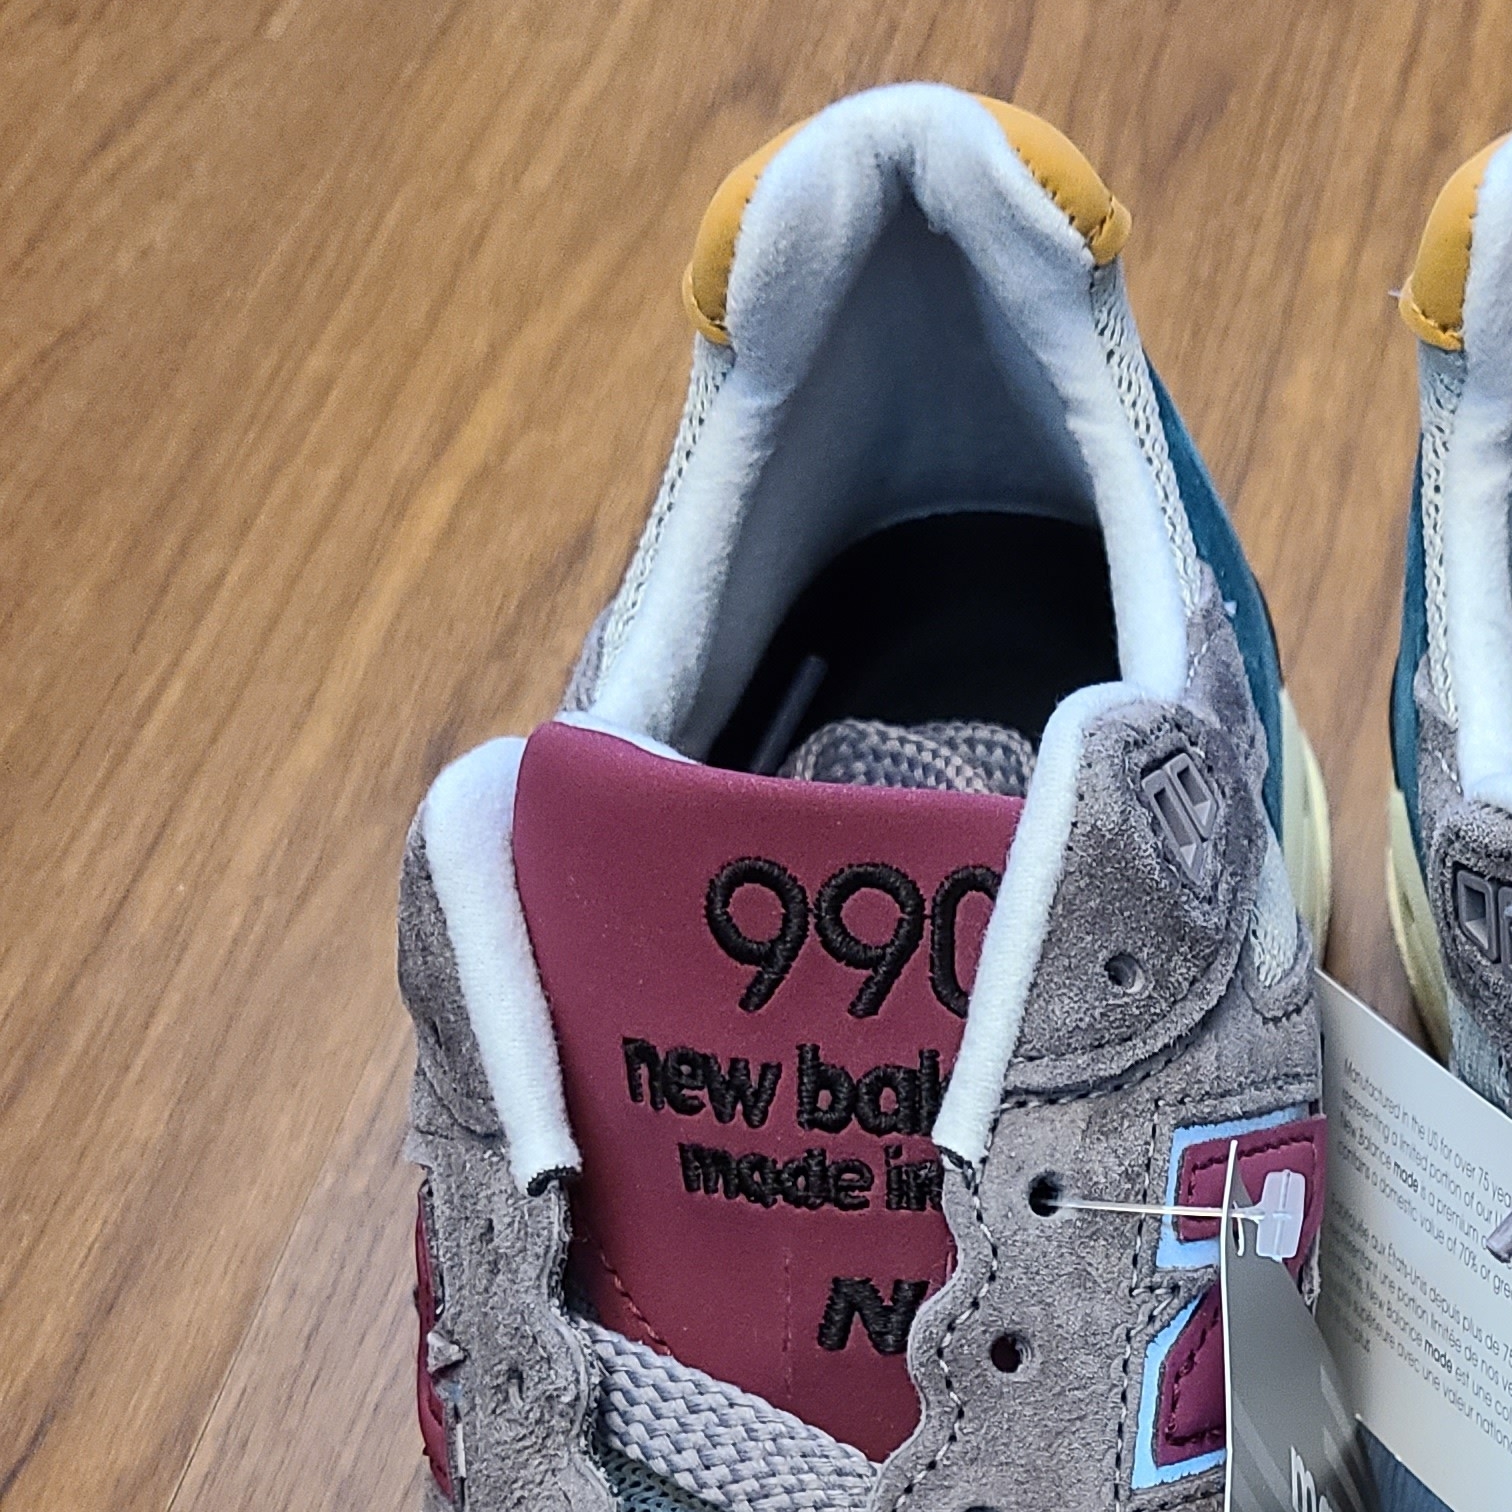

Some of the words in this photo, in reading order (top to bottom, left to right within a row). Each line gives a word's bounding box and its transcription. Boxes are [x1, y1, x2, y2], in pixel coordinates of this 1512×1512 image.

[705, 855, 1002, 1019] 990
[622, 1036, 783, 1129] new
[796, 1043, 951, 1136] bal
[1344, 1058, 1400, 1119] Manufactured
[1402, 1105, 1410, 1128] in
[1411, 1113, 1425, 1140] the
[1427, 1126, 1438, 1151] US
[1440, 1137, 1452, 1159] for
[1454, 1152, 1475, 1178] over
[1478, 1166, 1489, 1192] 75
[678, 1142, 874, 1209] made
[884, 1144, 944, 1211] in
[1358, 1127, 1391, 1170] Balance
[1393, 1160, 1418, 1193] made
[1436, 1198, 1479, 1244] premium
[1400, 1132, 1428, 1172] limited
[1429, 1162, 1462, 1198] portion
[1463, 1189, 1475, 1208] of
[1475, 1201, 1492, 1224] our
[1379, 1178, 1418, 1222] domestic
[1420, 1212, 1445, 1245] value
[1446, 1234, 1457, 1252] of
[1459, 1241, 1478, 1273] 70%
[1480, 1264, 1490, 1280] or
[1386, 1300, 1423, 1348] Balance
[1424, 1338, 1453, 1374] made
[1455, 1366, 1470, 1389] est
[1471, 1379, 1493, 1407] une
[1397, 1286, 1429, 1325] portion
[1430, 1313, 1462, 1353] limitée
[1464, 1345, 1479, 1367] de
[1480, 1359, 1499, 1386] nos
[1429, 1287, 1460, 1324] depuis
[1462, 1315, 1483, 1343] plus
[1484, 1332, 1500, 1356] de
[1397, 1341, 1421, 1374] avec
[1422, 1366, 1441, 1391] une
[1442, 1381, 1473, 1418] valeur
